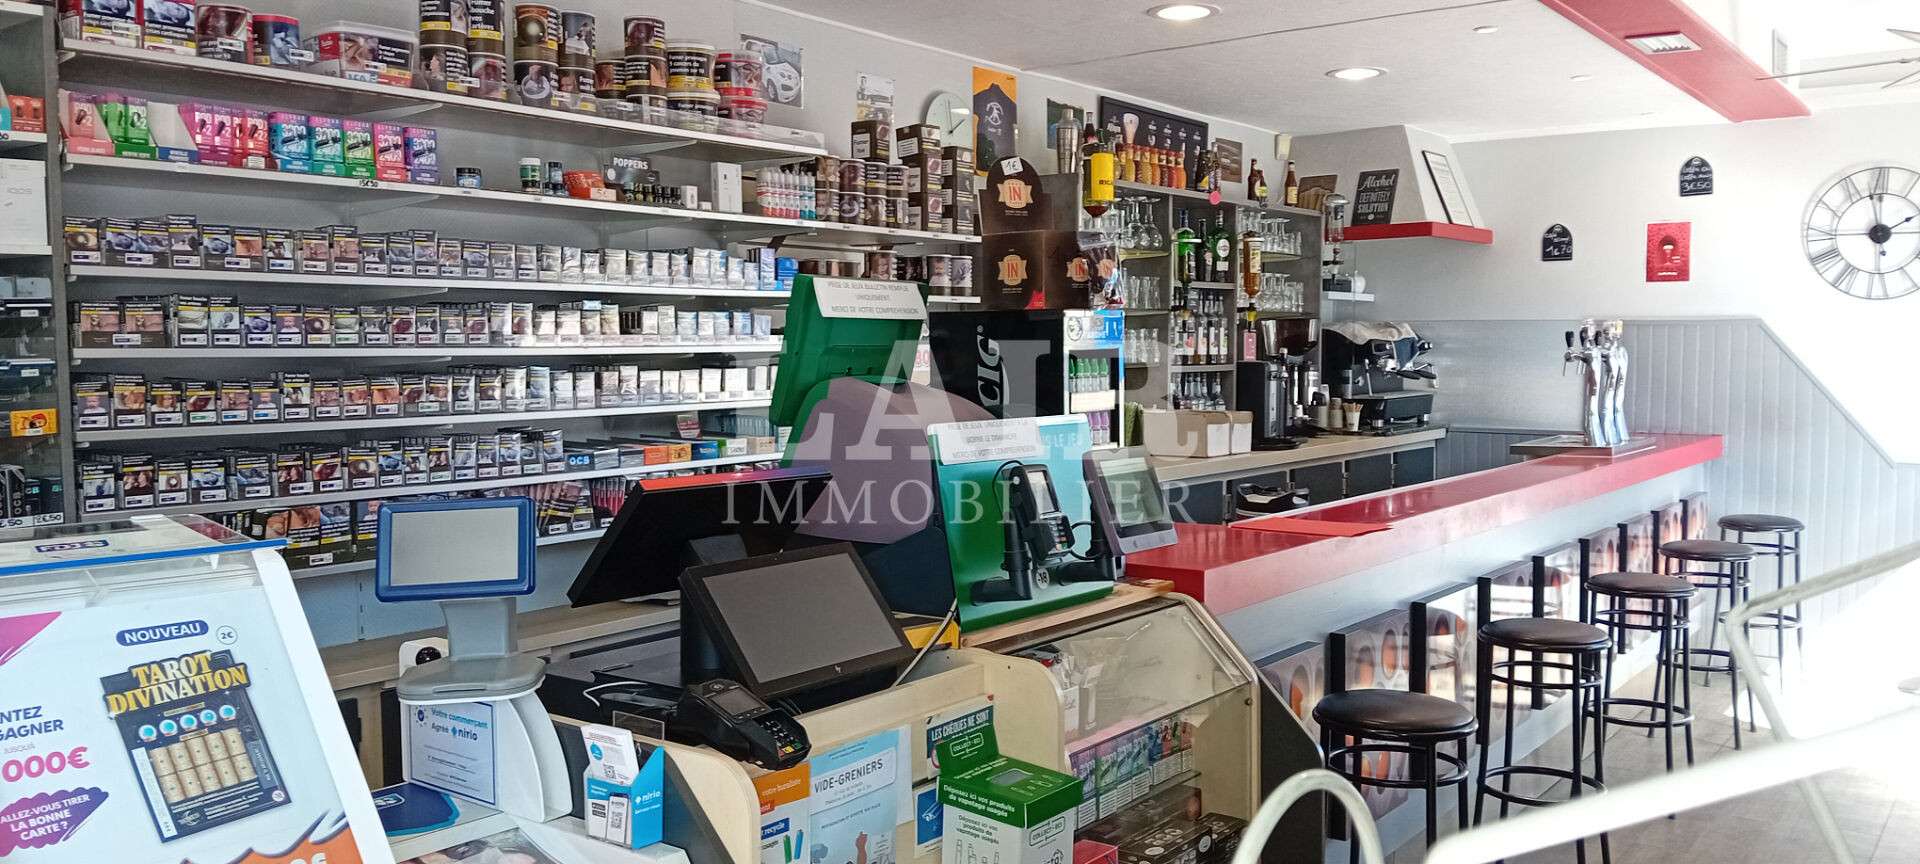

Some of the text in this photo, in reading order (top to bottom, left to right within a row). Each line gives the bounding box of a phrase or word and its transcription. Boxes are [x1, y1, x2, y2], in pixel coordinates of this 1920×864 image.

[612, 156, 649, 171] POPPERS
[1008, 184, 1022, 200] IN
[1359, 174, 1396, 191] Alcohol
[124, 622, 202, 644] NOUVEAU
[220, 631, 235, 640] 2€
[132, 651, 212, 688] TAROT
[106, 664, 249, 715] DIVINATION
[458, 727, 478, 741] nirio
[931, 728, 943, 741] LES
[976, 709, 990, 724] SONT
[2, 746, 90, 783] 000€
[814, 758, 883, 793] VIDE-GRENIERS
[0, 794, 91, 824] ALLEZ-VOUS TIRER
[943, 784, 969, 797] Déposez
[978, 796, 989, 804] vos
[989, 798, 1016, 813] produits
[10, 808, 73, 833] LA BONNE
[20, 823, 61, 841] CARTE
